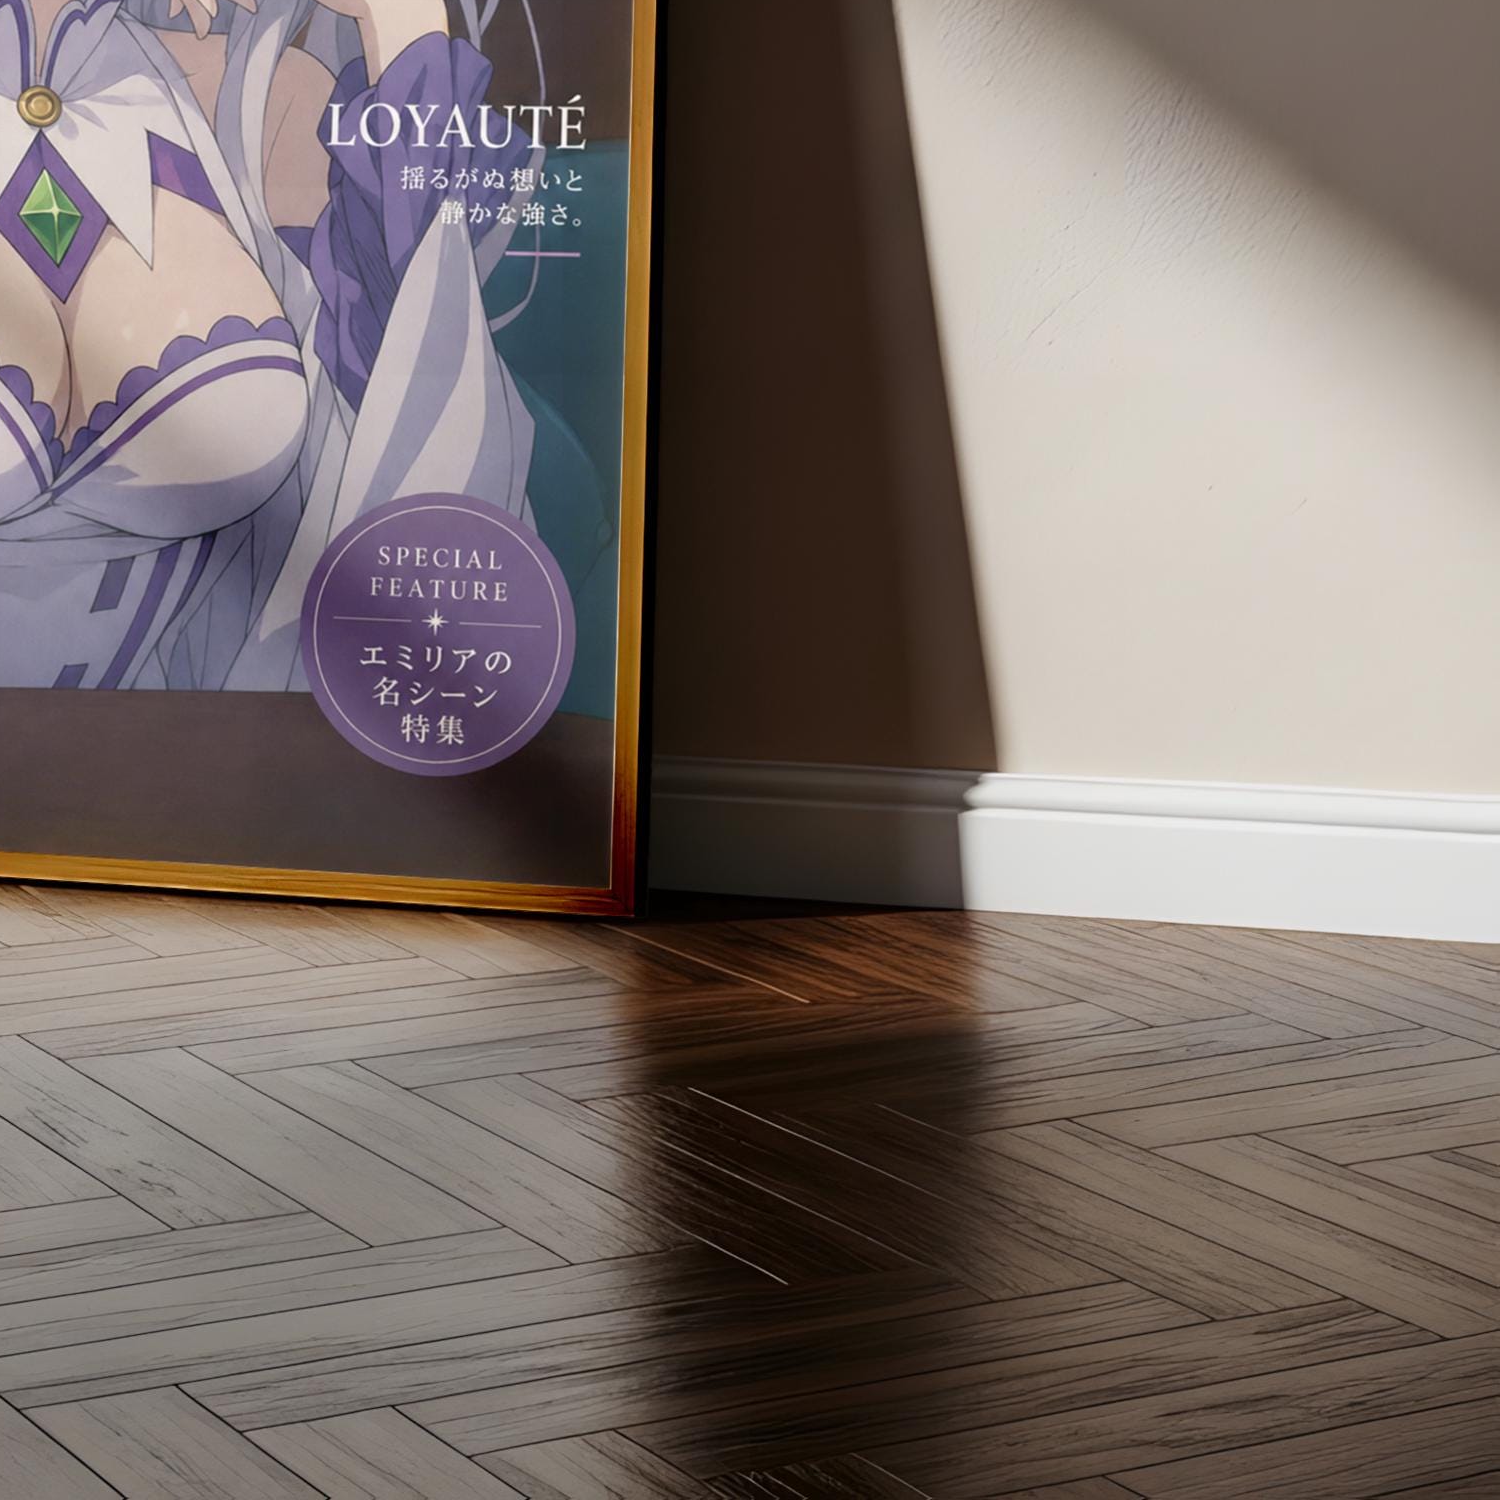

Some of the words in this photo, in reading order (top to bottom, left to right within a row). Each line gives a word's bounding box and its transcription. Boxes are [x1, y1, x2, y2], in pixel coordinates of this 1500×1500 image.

[326, 94, 587, 151] LOYAUTÉ
[400, 165, 584, 193] 揺るがぬ想いと
[439, 200, 583, 228] 静かな強さ。
[377, 545, 502, 571] SPECIAL
[370, 576, 509, 602] FEATURE
[359, 645, 512, 675] エミリアの
[372, 676, 498, 708] 名シーン
[400, 713, 465, 745] 特集
